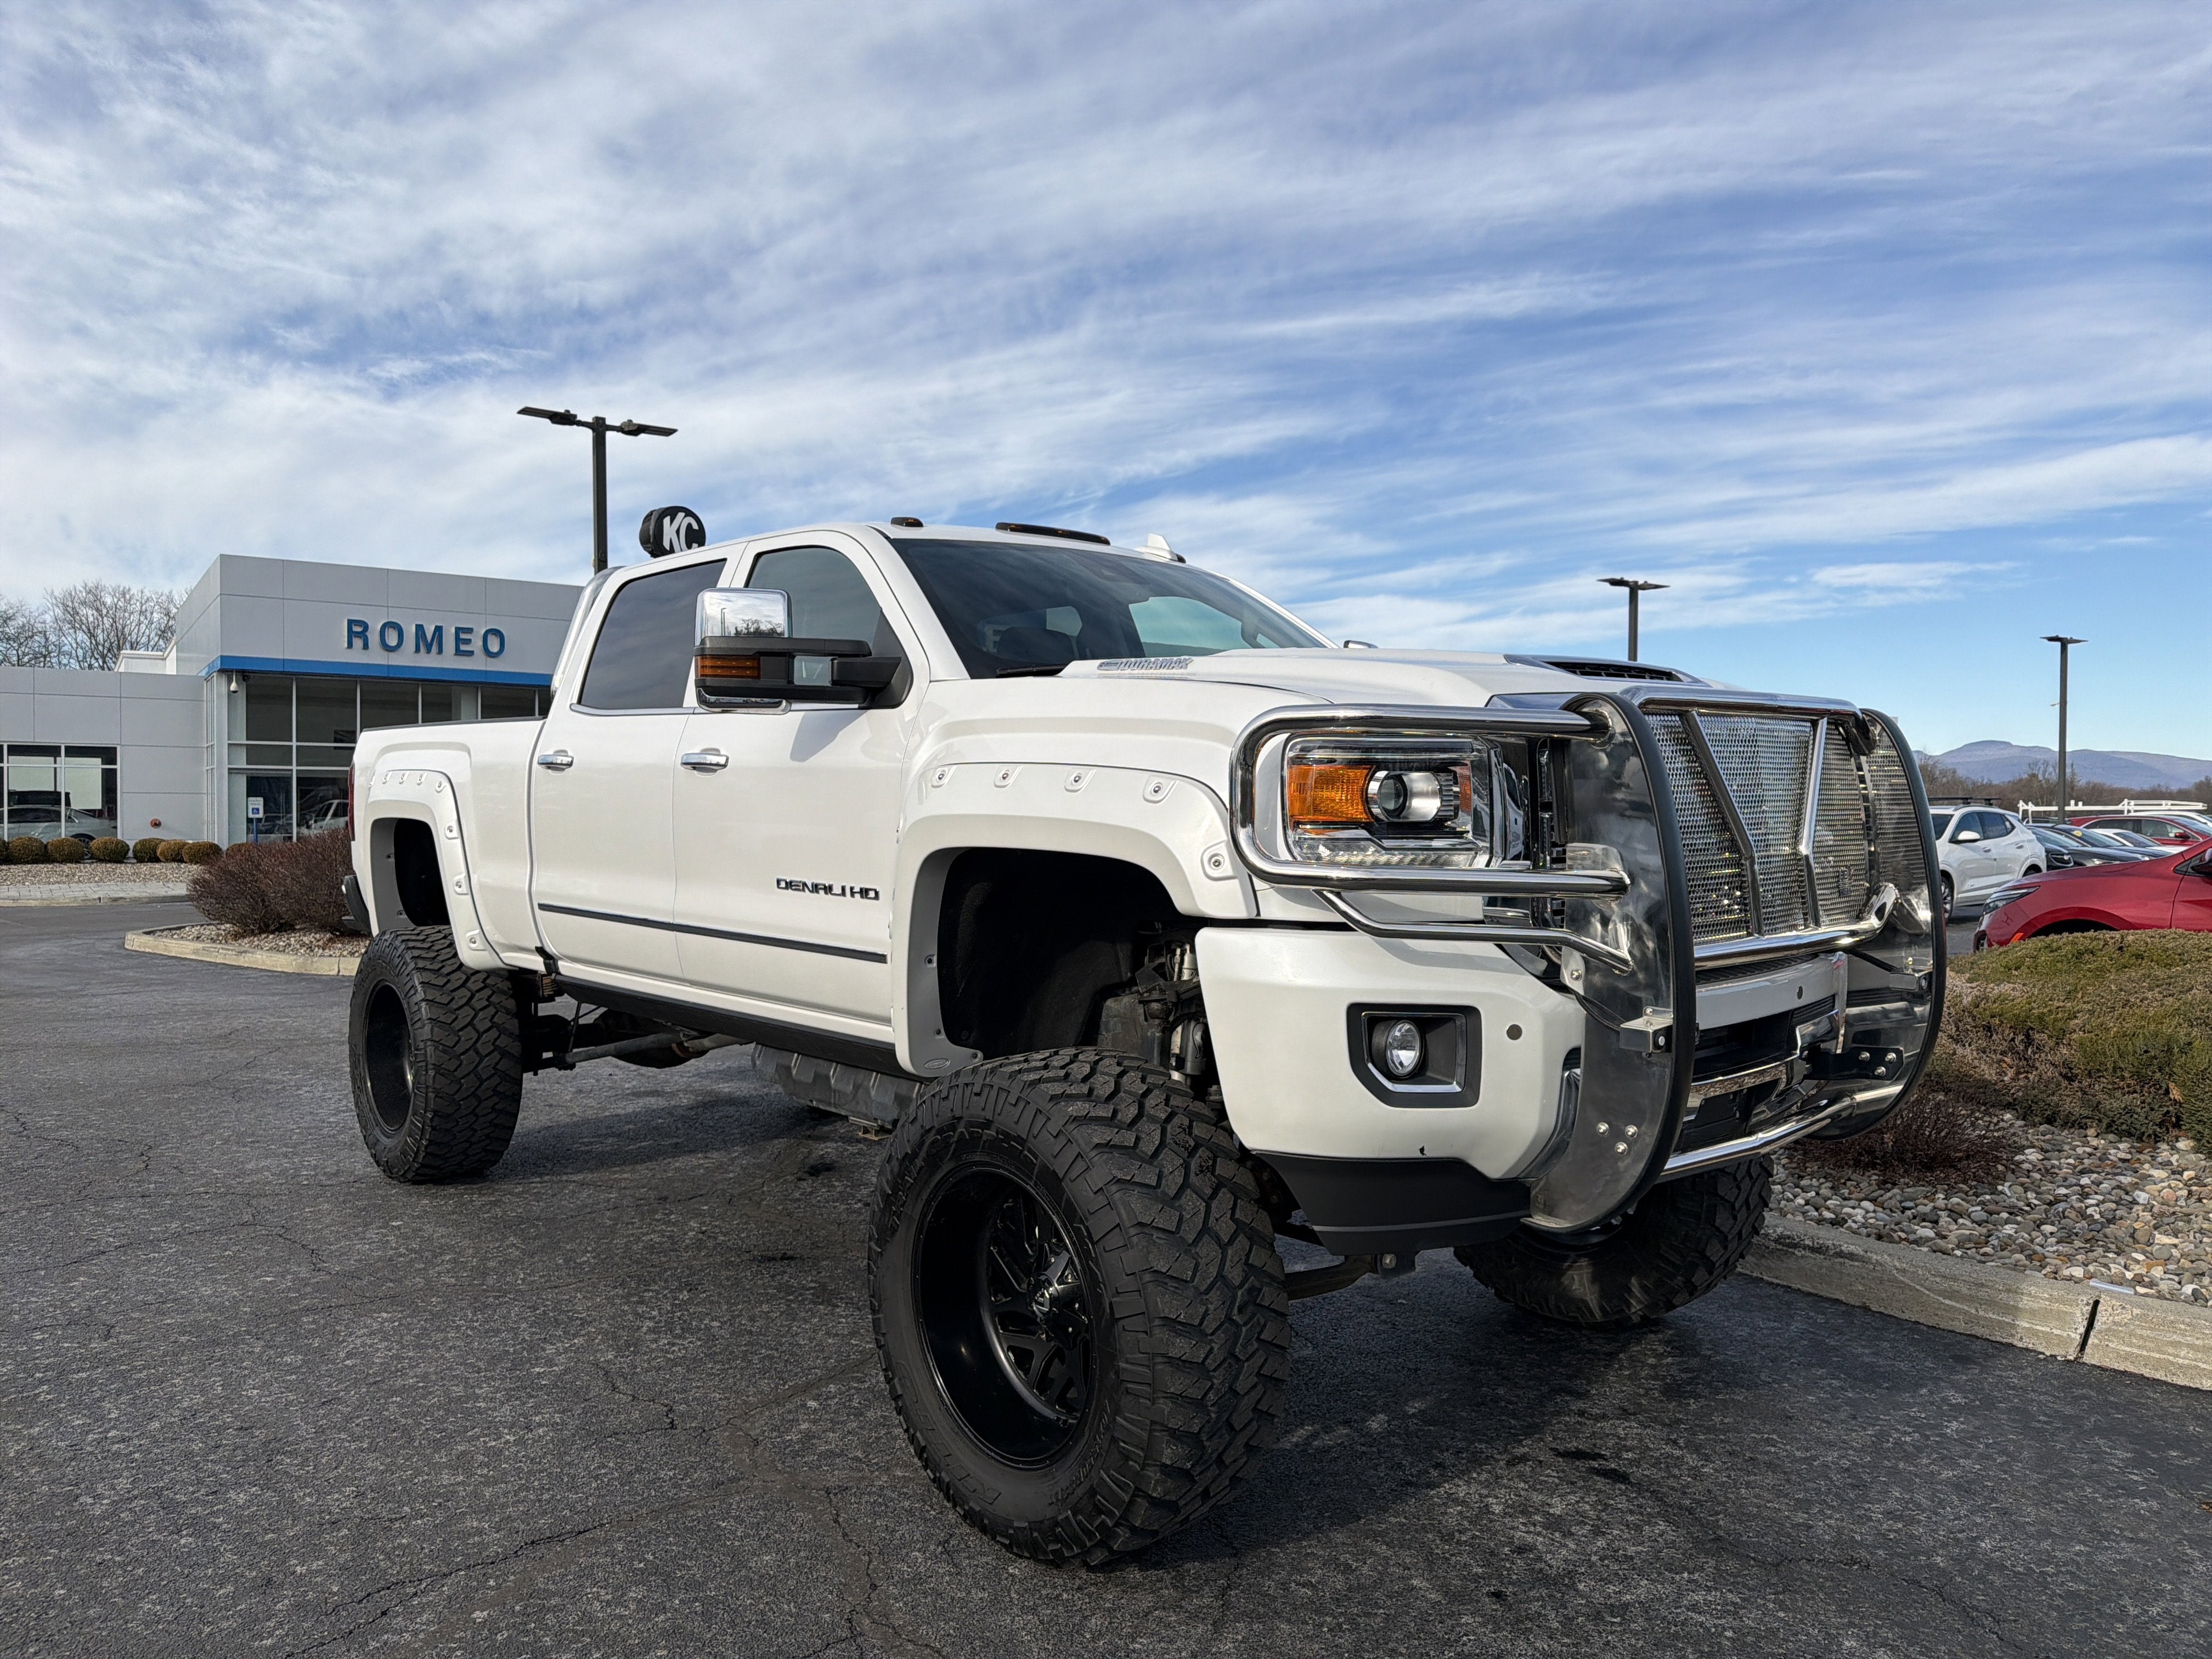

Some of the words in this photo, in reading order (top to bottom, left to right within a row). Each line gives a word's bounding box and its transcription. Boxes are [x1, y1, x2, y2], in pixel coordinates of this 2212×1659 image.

[663, 512, 699, 554] KC
[346, 618, 505, 658] ROMEO
[1119, 658, 1194, 671] DURAMAX
[776, 877, 847, 897] DENALI
[850, 885, 880, 901] HD
